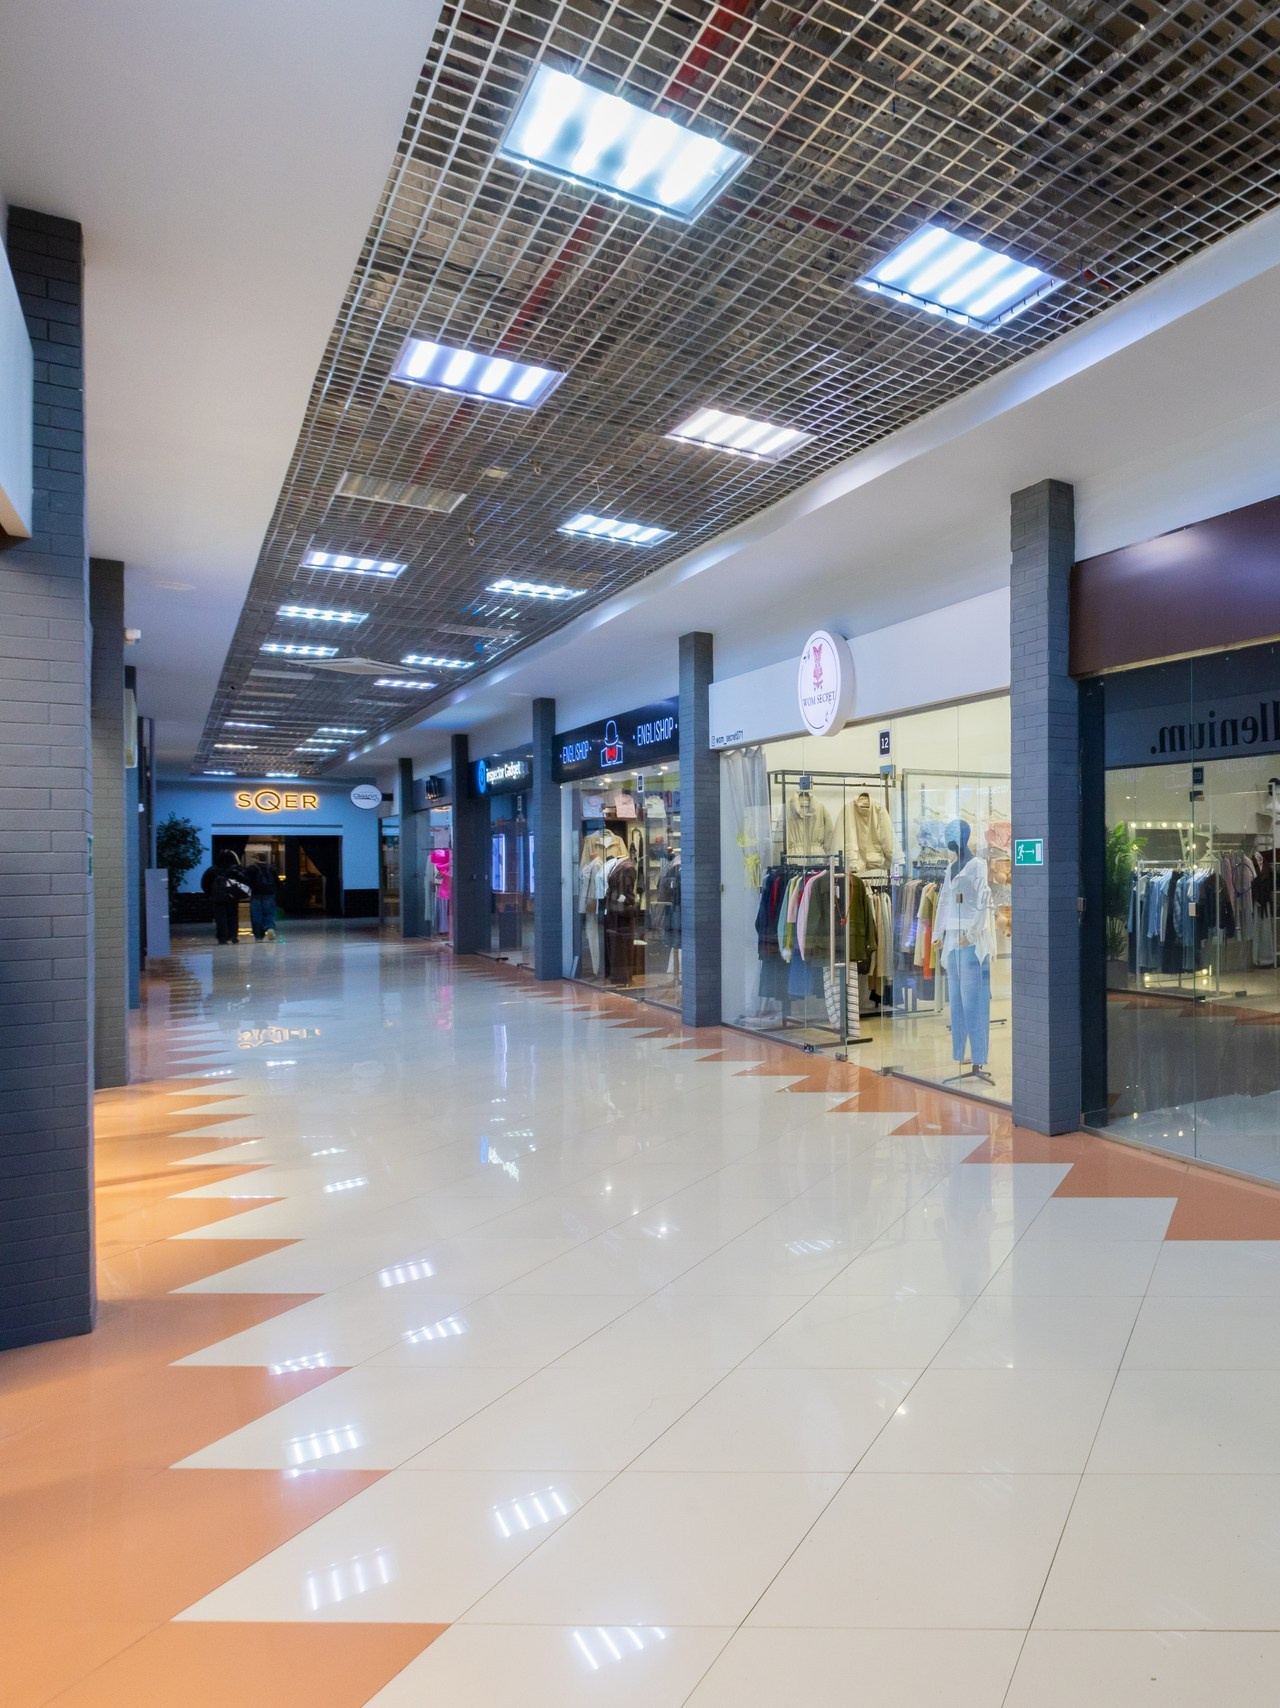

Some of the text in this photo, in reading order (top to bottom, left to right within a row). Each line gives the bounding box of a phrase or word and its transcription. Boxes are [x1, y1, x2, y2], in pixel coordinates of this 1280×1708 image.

[816, 691, 836, 704] SECRET
[636, 717, 674, 746] ENGLISHOP
[562, 740, 590, 764] ENGLISHOP
[881, 737, 889, 749] 12
[236, 790, 319, 812] SQER
